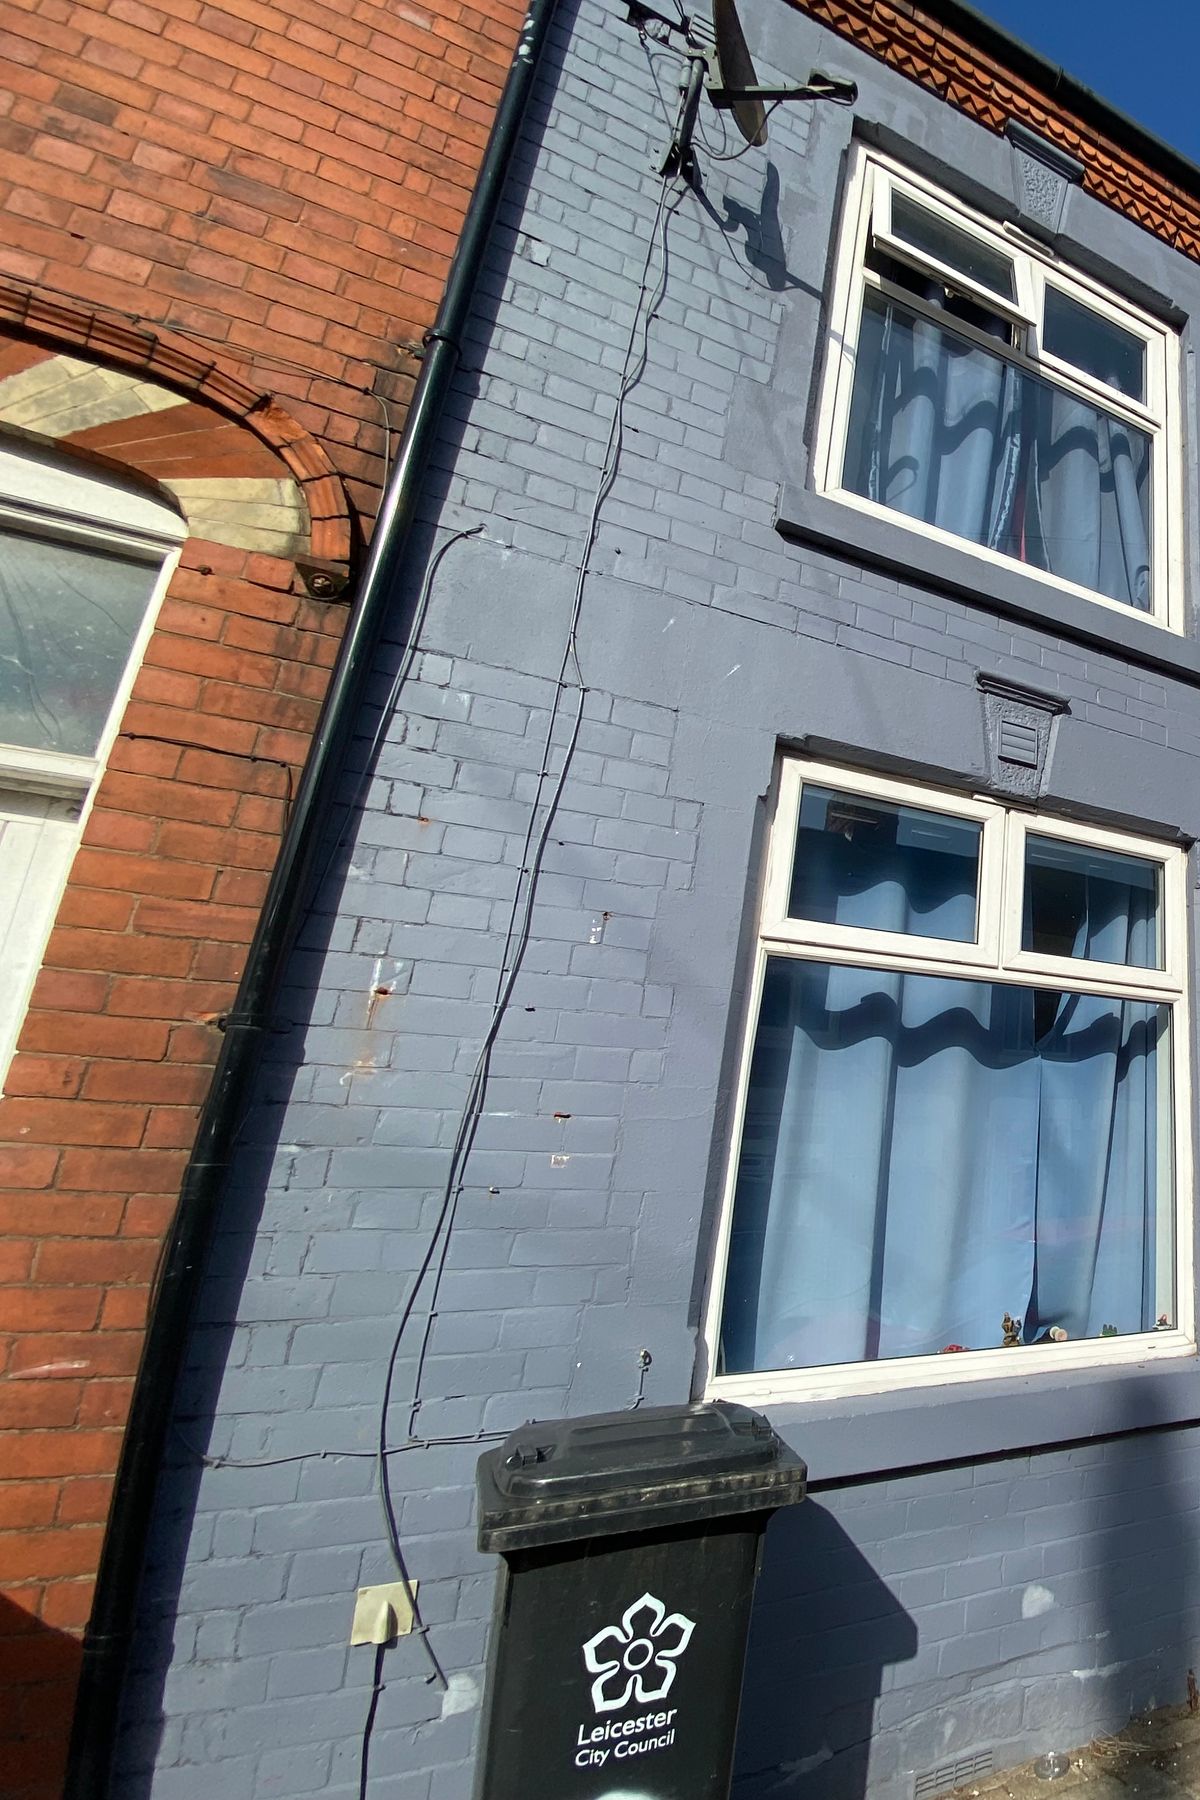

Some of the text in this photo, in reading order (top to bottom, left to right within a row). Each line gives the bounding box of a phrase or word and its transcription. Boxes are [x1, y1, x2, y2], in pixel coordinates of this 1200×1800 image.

[577, 1708, 678, 1746] Leicester
[575, 1728, 676, 1767] City Council
